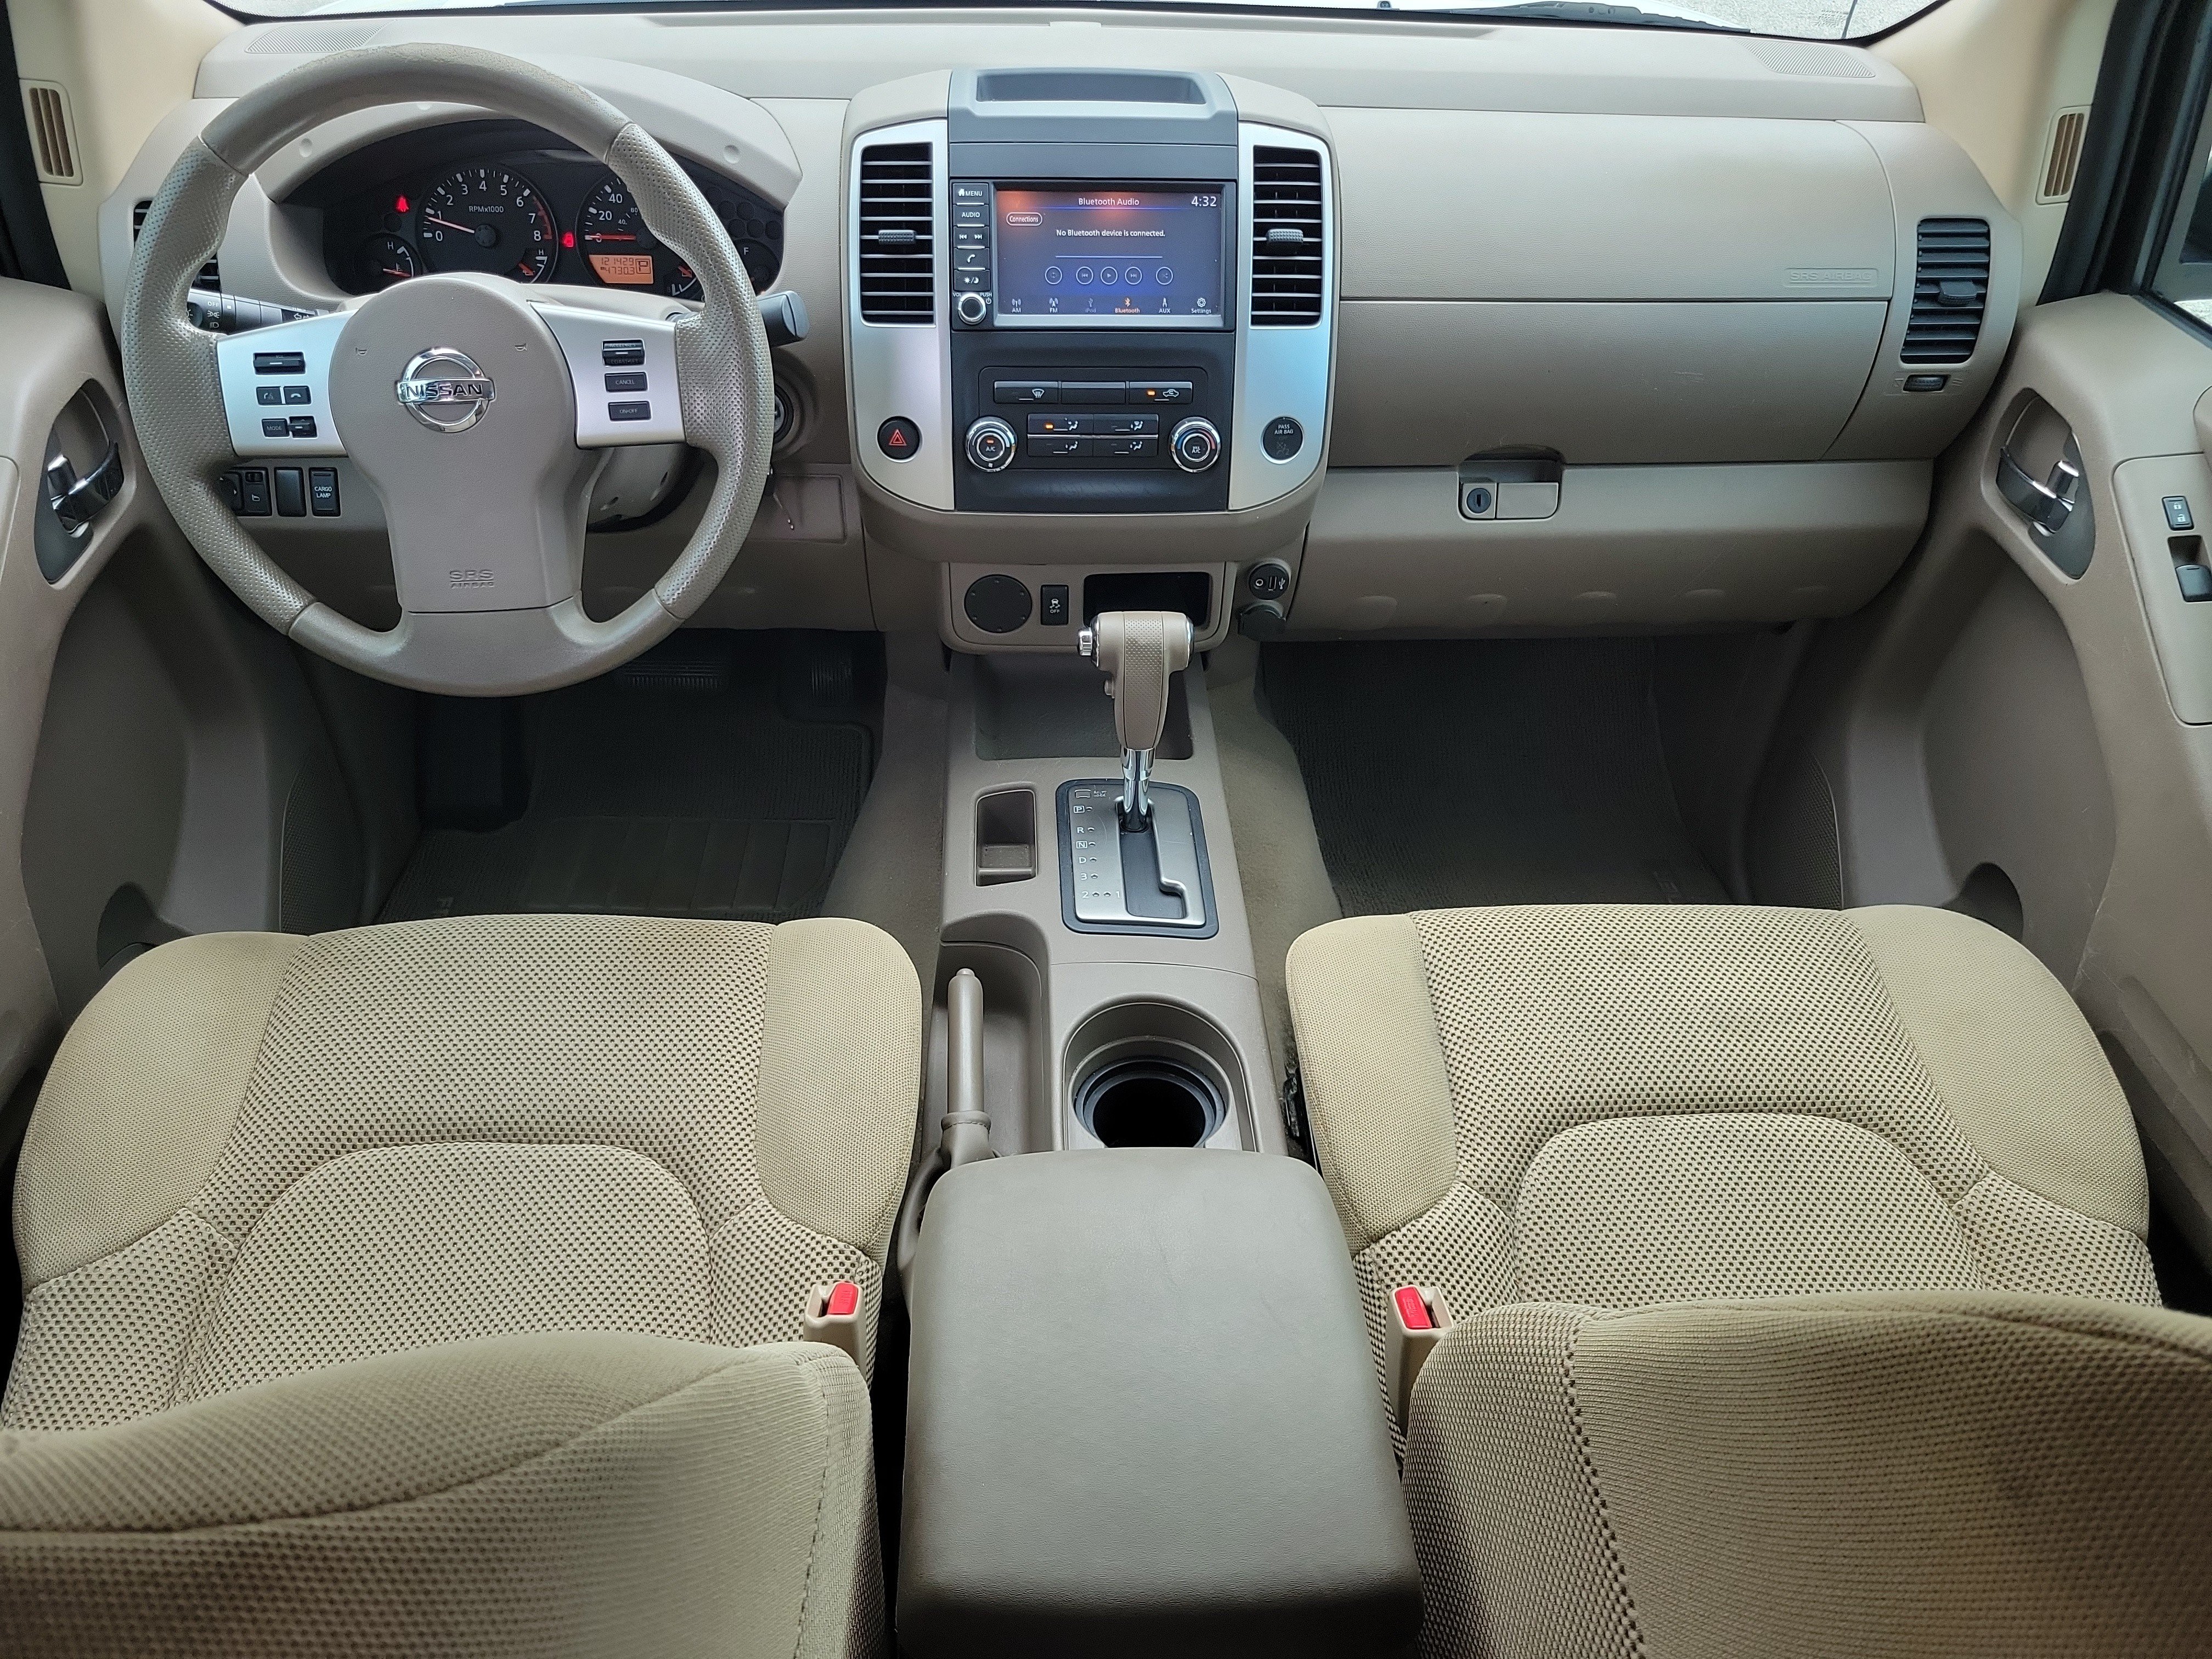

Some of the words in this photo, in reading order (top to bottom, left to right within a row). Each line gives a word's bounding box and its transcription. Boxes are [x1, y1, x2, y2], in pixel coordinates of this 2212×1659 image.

[461, 184, 469, 195] 3
[479, 180, 487, 191] 4
[500, 185, 507, 196] 5
[446, 195, 454, 206] 2
[516, 196, 524, 207] 6
[608, 193, 623, 204] 40
[1079, 198, 1115, 206] Bluetooth
[1191, 196, 1217, 207] 4:32
[528, 213, 536, 224] 7
[599, 210, 612, 221] 20
[435, 230, 443, 241] 0
[534, 230, 541, 241] 8
[387, 241, 394, 250] H
[743, 247, 749, 256] F
[602, 257, 634, 266] 121429
[406, 383, 483, 398] NISSAN
